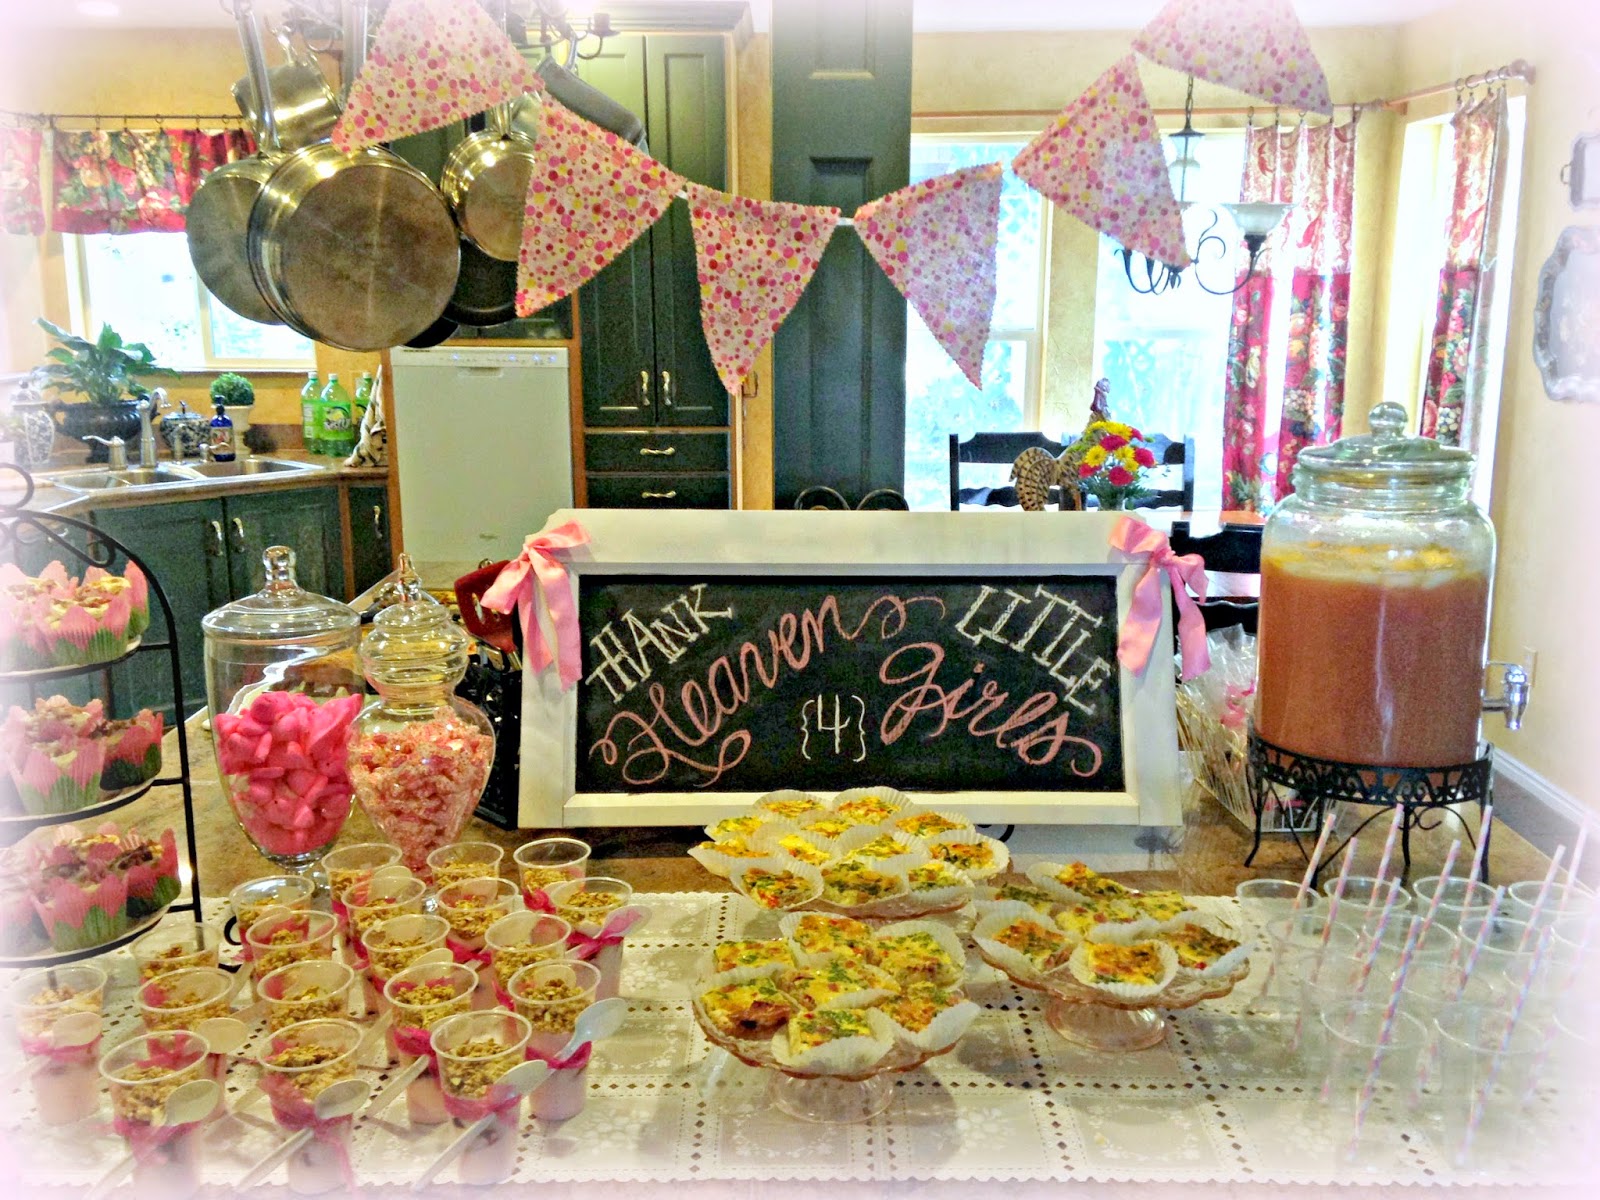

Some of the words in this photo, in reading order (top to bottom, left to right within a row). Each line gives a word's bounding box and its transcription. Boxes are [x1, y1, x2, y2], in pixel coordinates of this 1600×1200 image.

[586, 584, 734, 702] THANK
[589, 595, 945, 787] Heaven
[955, 585, 1112, 715] LITTLE
[879, 642, 1103, 778] Girls
